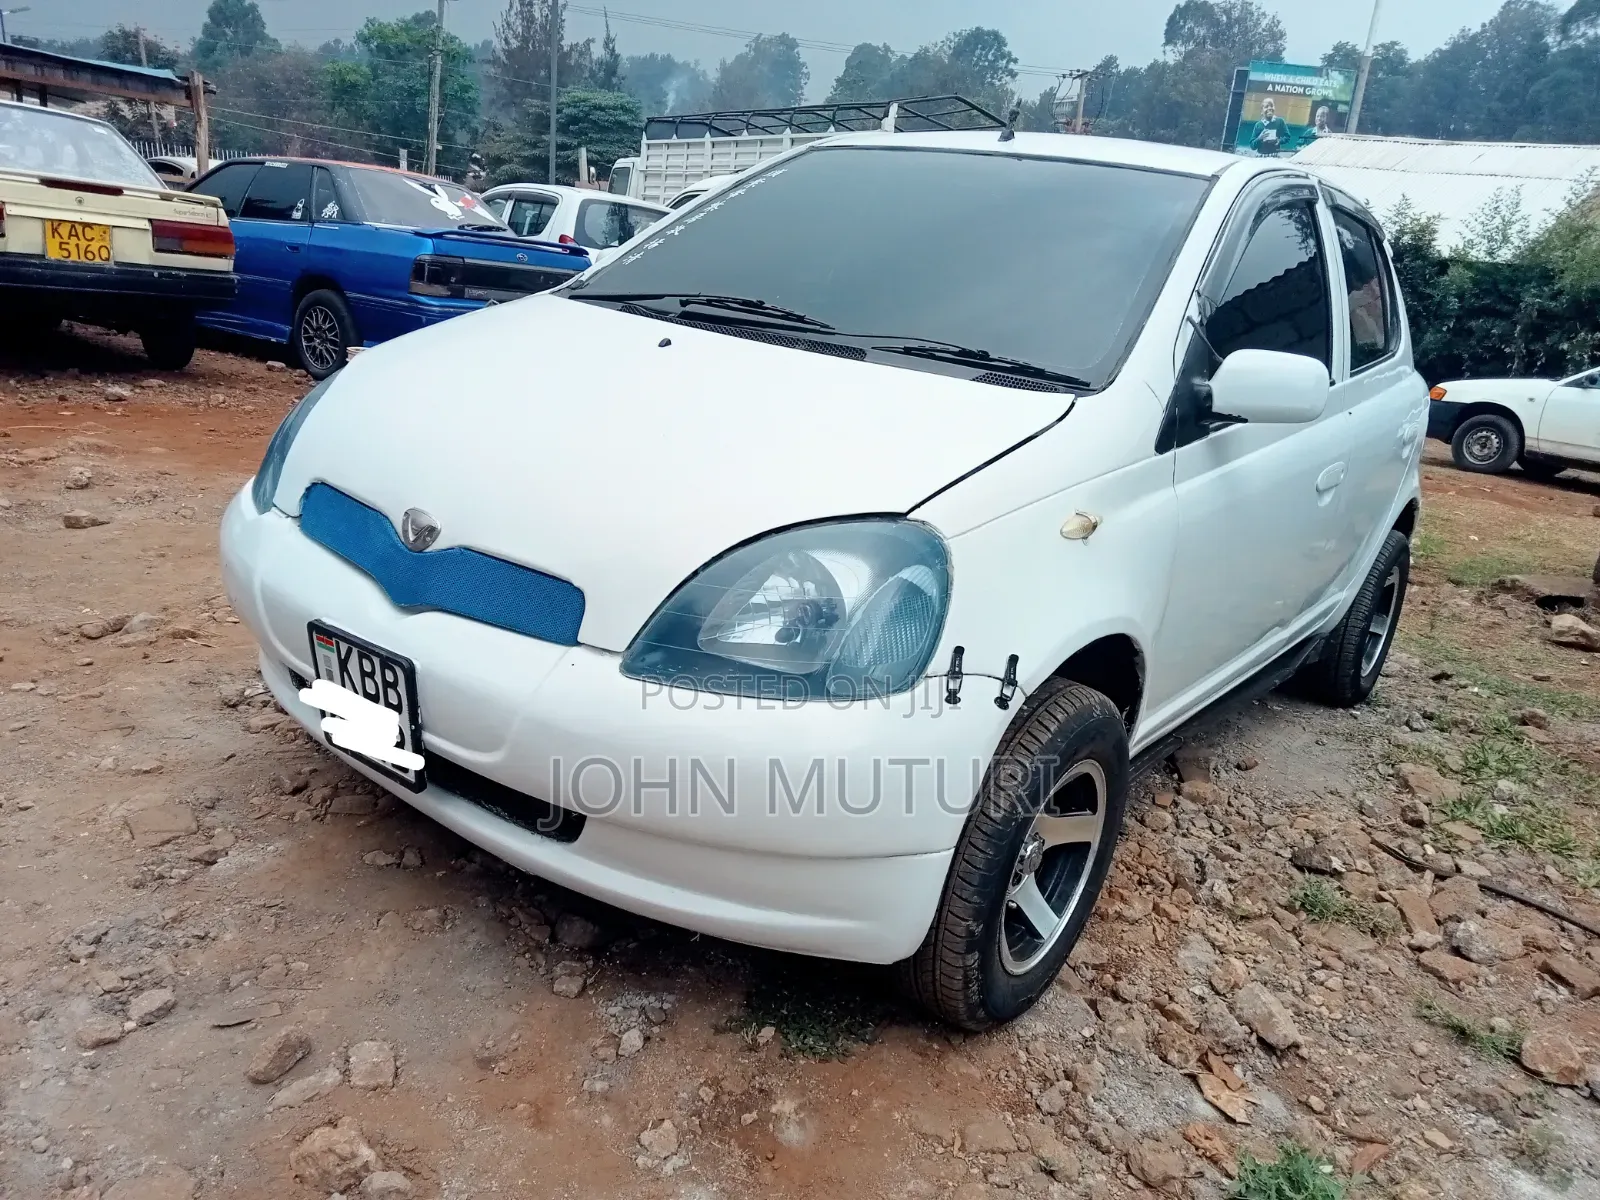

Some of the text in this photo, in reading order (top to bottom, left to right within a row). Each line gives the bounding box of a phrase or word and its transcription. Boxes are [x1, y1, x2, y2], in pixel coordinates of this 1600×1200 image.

[1264, 73, 1288, 83] WHEN
[1296, 76, 1319, 86] CHILD
[1266, 83, 1334, 97] A NATION GROWS
[51, 222, 95, 242] KAC
[335, 639, 403, 715] KBB
